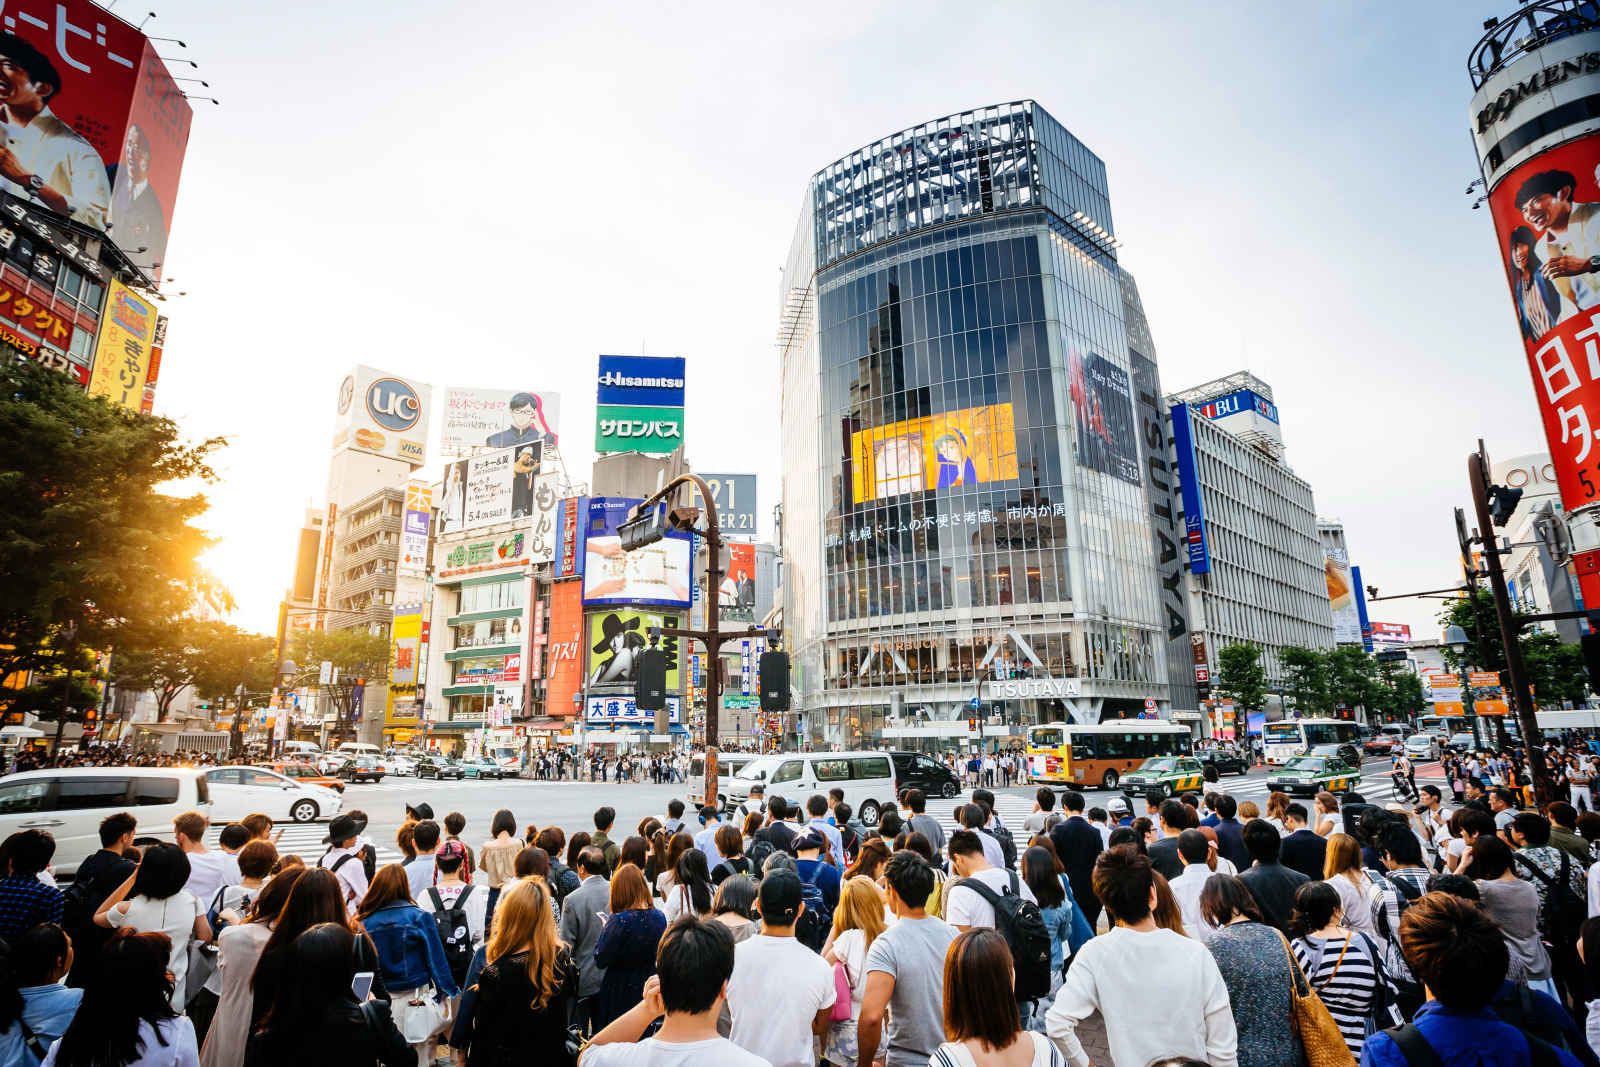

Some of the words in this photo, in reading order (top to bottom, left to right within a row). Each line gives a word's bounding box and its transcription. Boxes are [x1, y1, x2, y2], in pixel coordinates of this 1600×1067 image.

[0, 0, 134, 74] ービー
[597, 371, 684, 389] Hisamitsu
[372, 386, 416, 420] UC
[599, 418, 681, 439] サロンパス
[401, 441, 422, 456] VISA
[739, 513, 754, 529] 21
[1140, 390, 1187, 641] TSUTAYA
[1187, 514, 1205, 563] SEIBU
[550, 631, 581, 680] クスリ
[991, 680, 1079, 698] TSUTAYA
